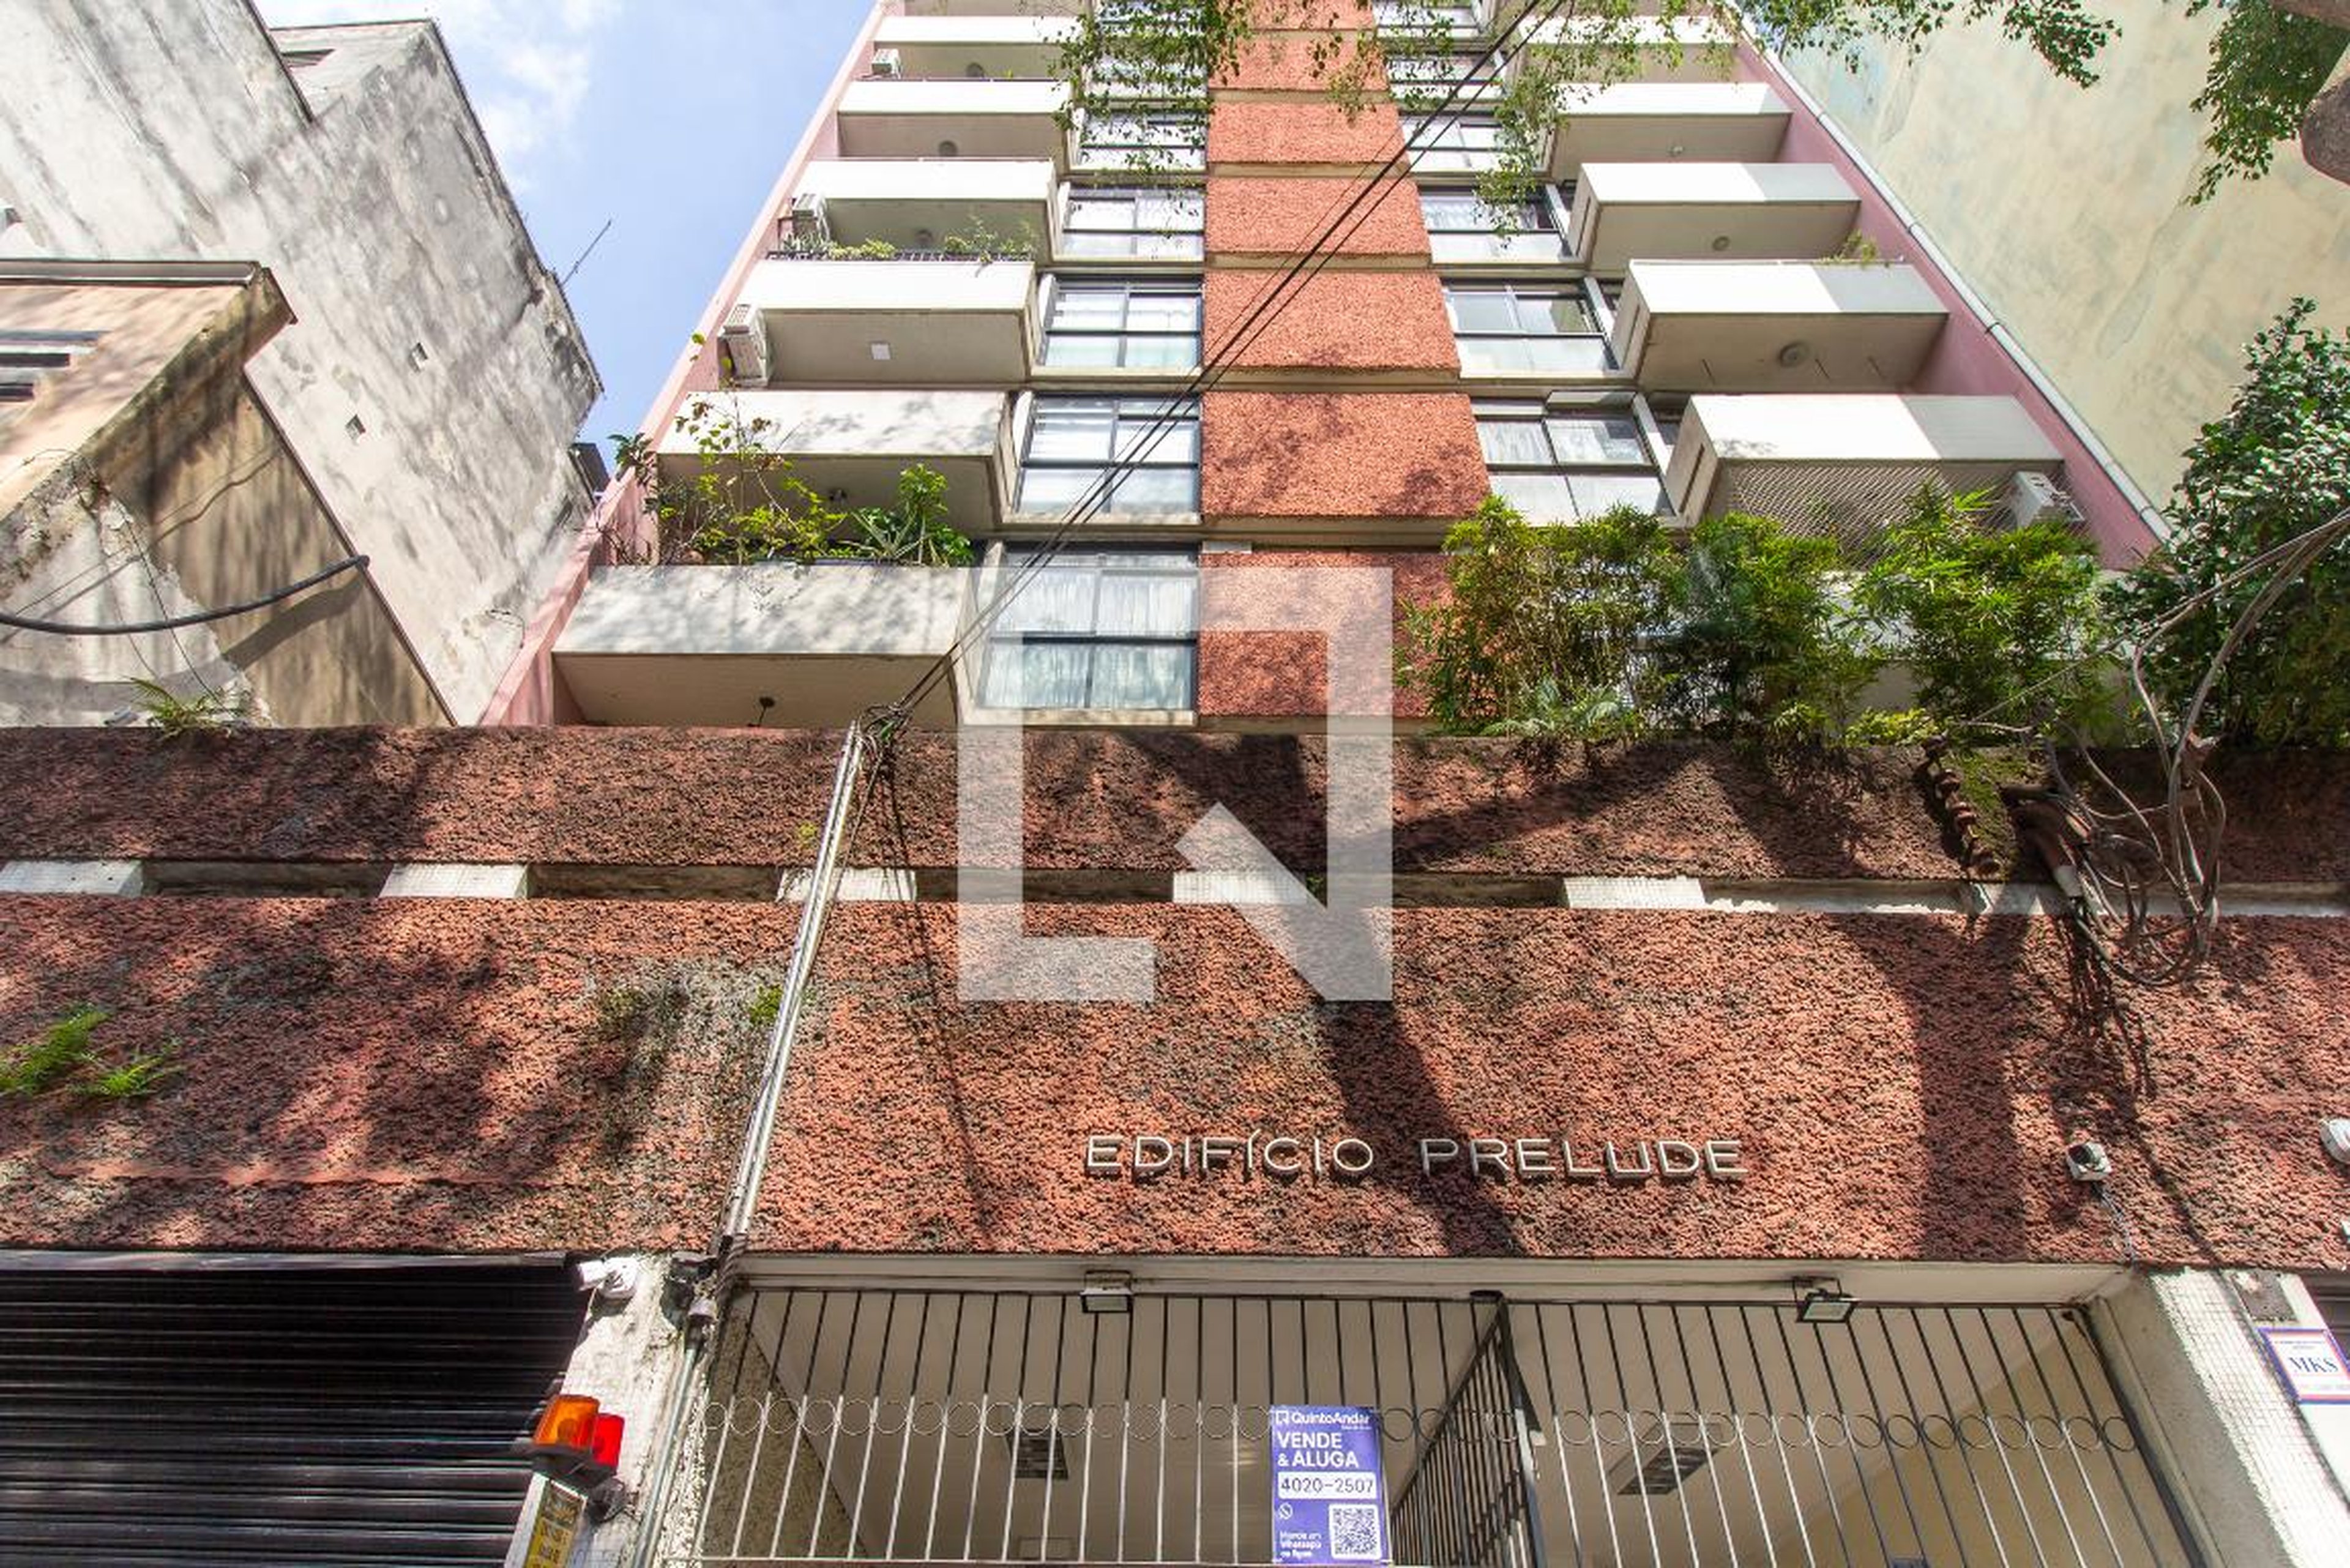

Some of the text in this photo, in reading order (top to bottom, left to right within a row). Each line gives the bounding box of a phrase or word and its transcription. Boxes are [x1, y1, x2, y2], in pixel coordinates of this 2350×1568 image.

[1086, 1129, 1749, 1176] EDIFÍCIO PRELUDE
[1291, 1412, 1370, 1425] QuintoAndar
[1277, 1432, 1342, 1449] VENDE
[1277, 1450, 1359, 1468] & ALUGA
[1280, 1477, 1373, 1493] 4020-2507
